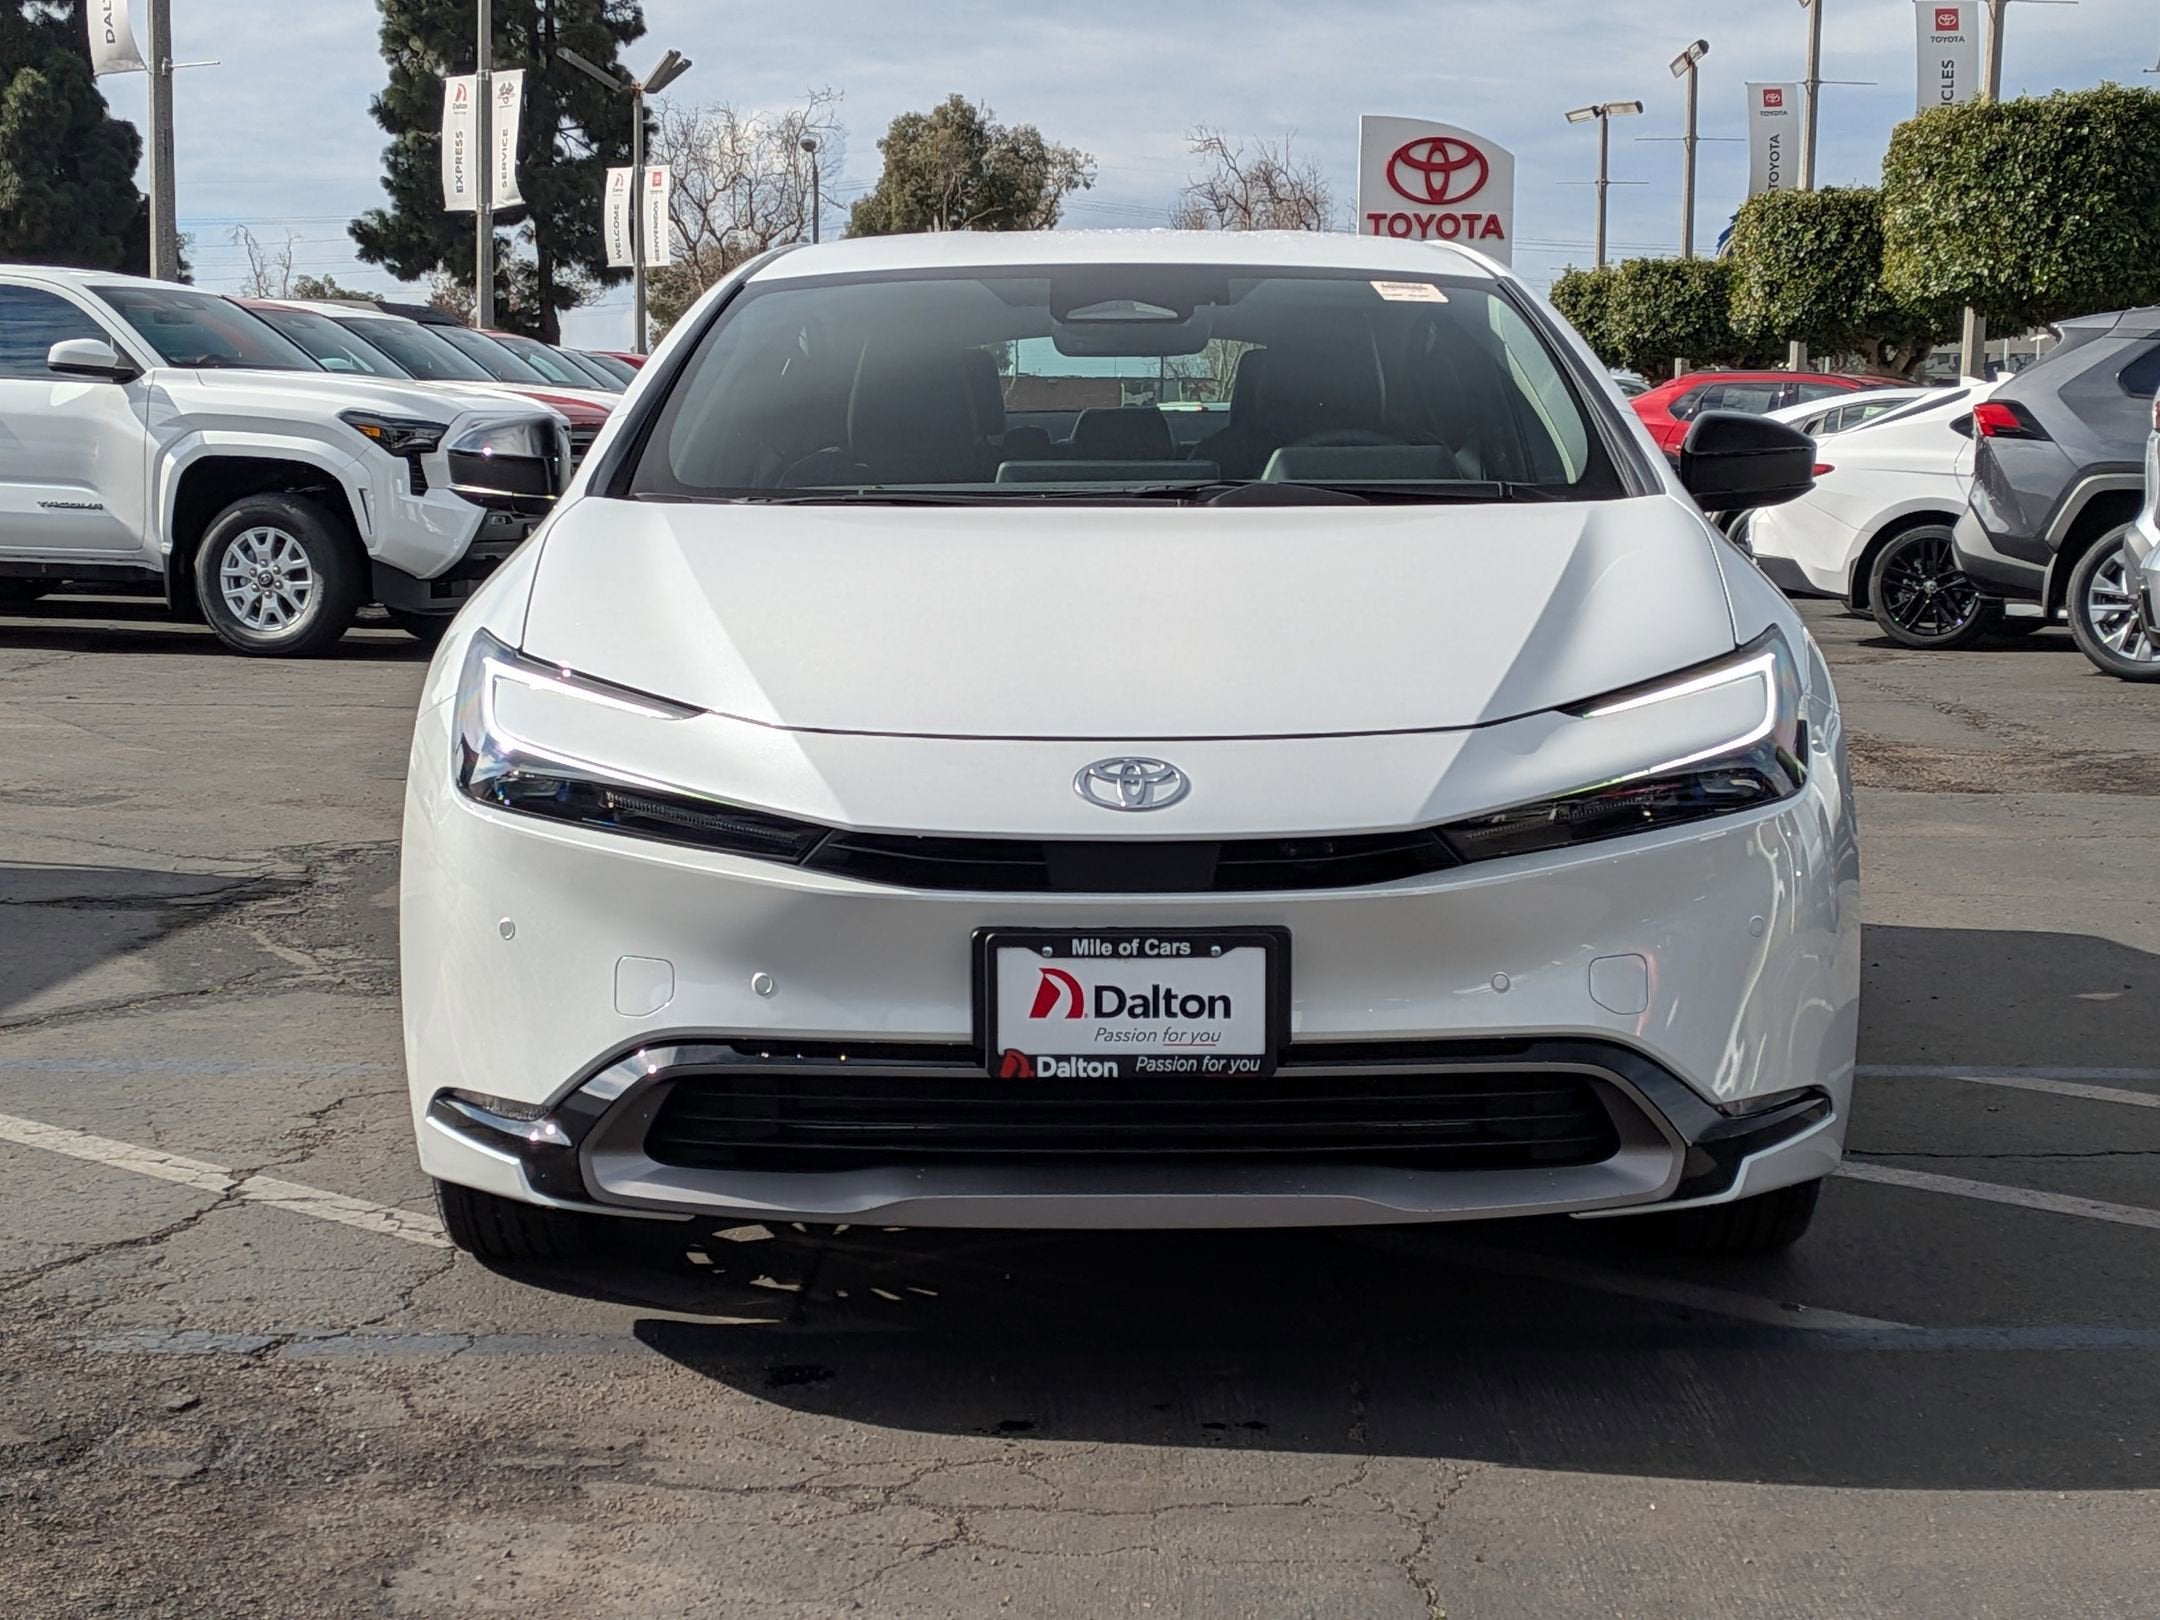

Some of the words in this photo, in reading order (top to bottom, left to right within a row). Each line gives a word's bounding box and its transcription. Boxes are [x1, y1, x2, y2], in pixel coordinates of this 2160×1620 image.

[103, 0, 116, 44] DAL
[1941, 59, 1955, 106] ICLES
[455, 130, 464, 193] EXPRESS
[501, 128, 509, 188] SERVICE
[1768, 133, 1780, 191] TOYOTA
[613, 204, 622, 260] WELCOME
[1367, 212, 1505, 240] TOYOTA
[1072, 938, 1112, 956] Mile
[1118, 938, 1140, 956] of
[1144, 938, 1191, 956] Cars
[1094, 984, 1231, 1019] Dalton
[1094, 1027, 1157, 1042] Passion
[1161, 1026, 1187, 1042] for
[1189, 1031, 1222, 1046] you
[1037, 1056, 1118, 1078] Dalton
[1135, 1055, 1197, 1072] Passion
[1201, 1055, 1226, 1072] for
[1227, 1058, 1260, 1075] you
